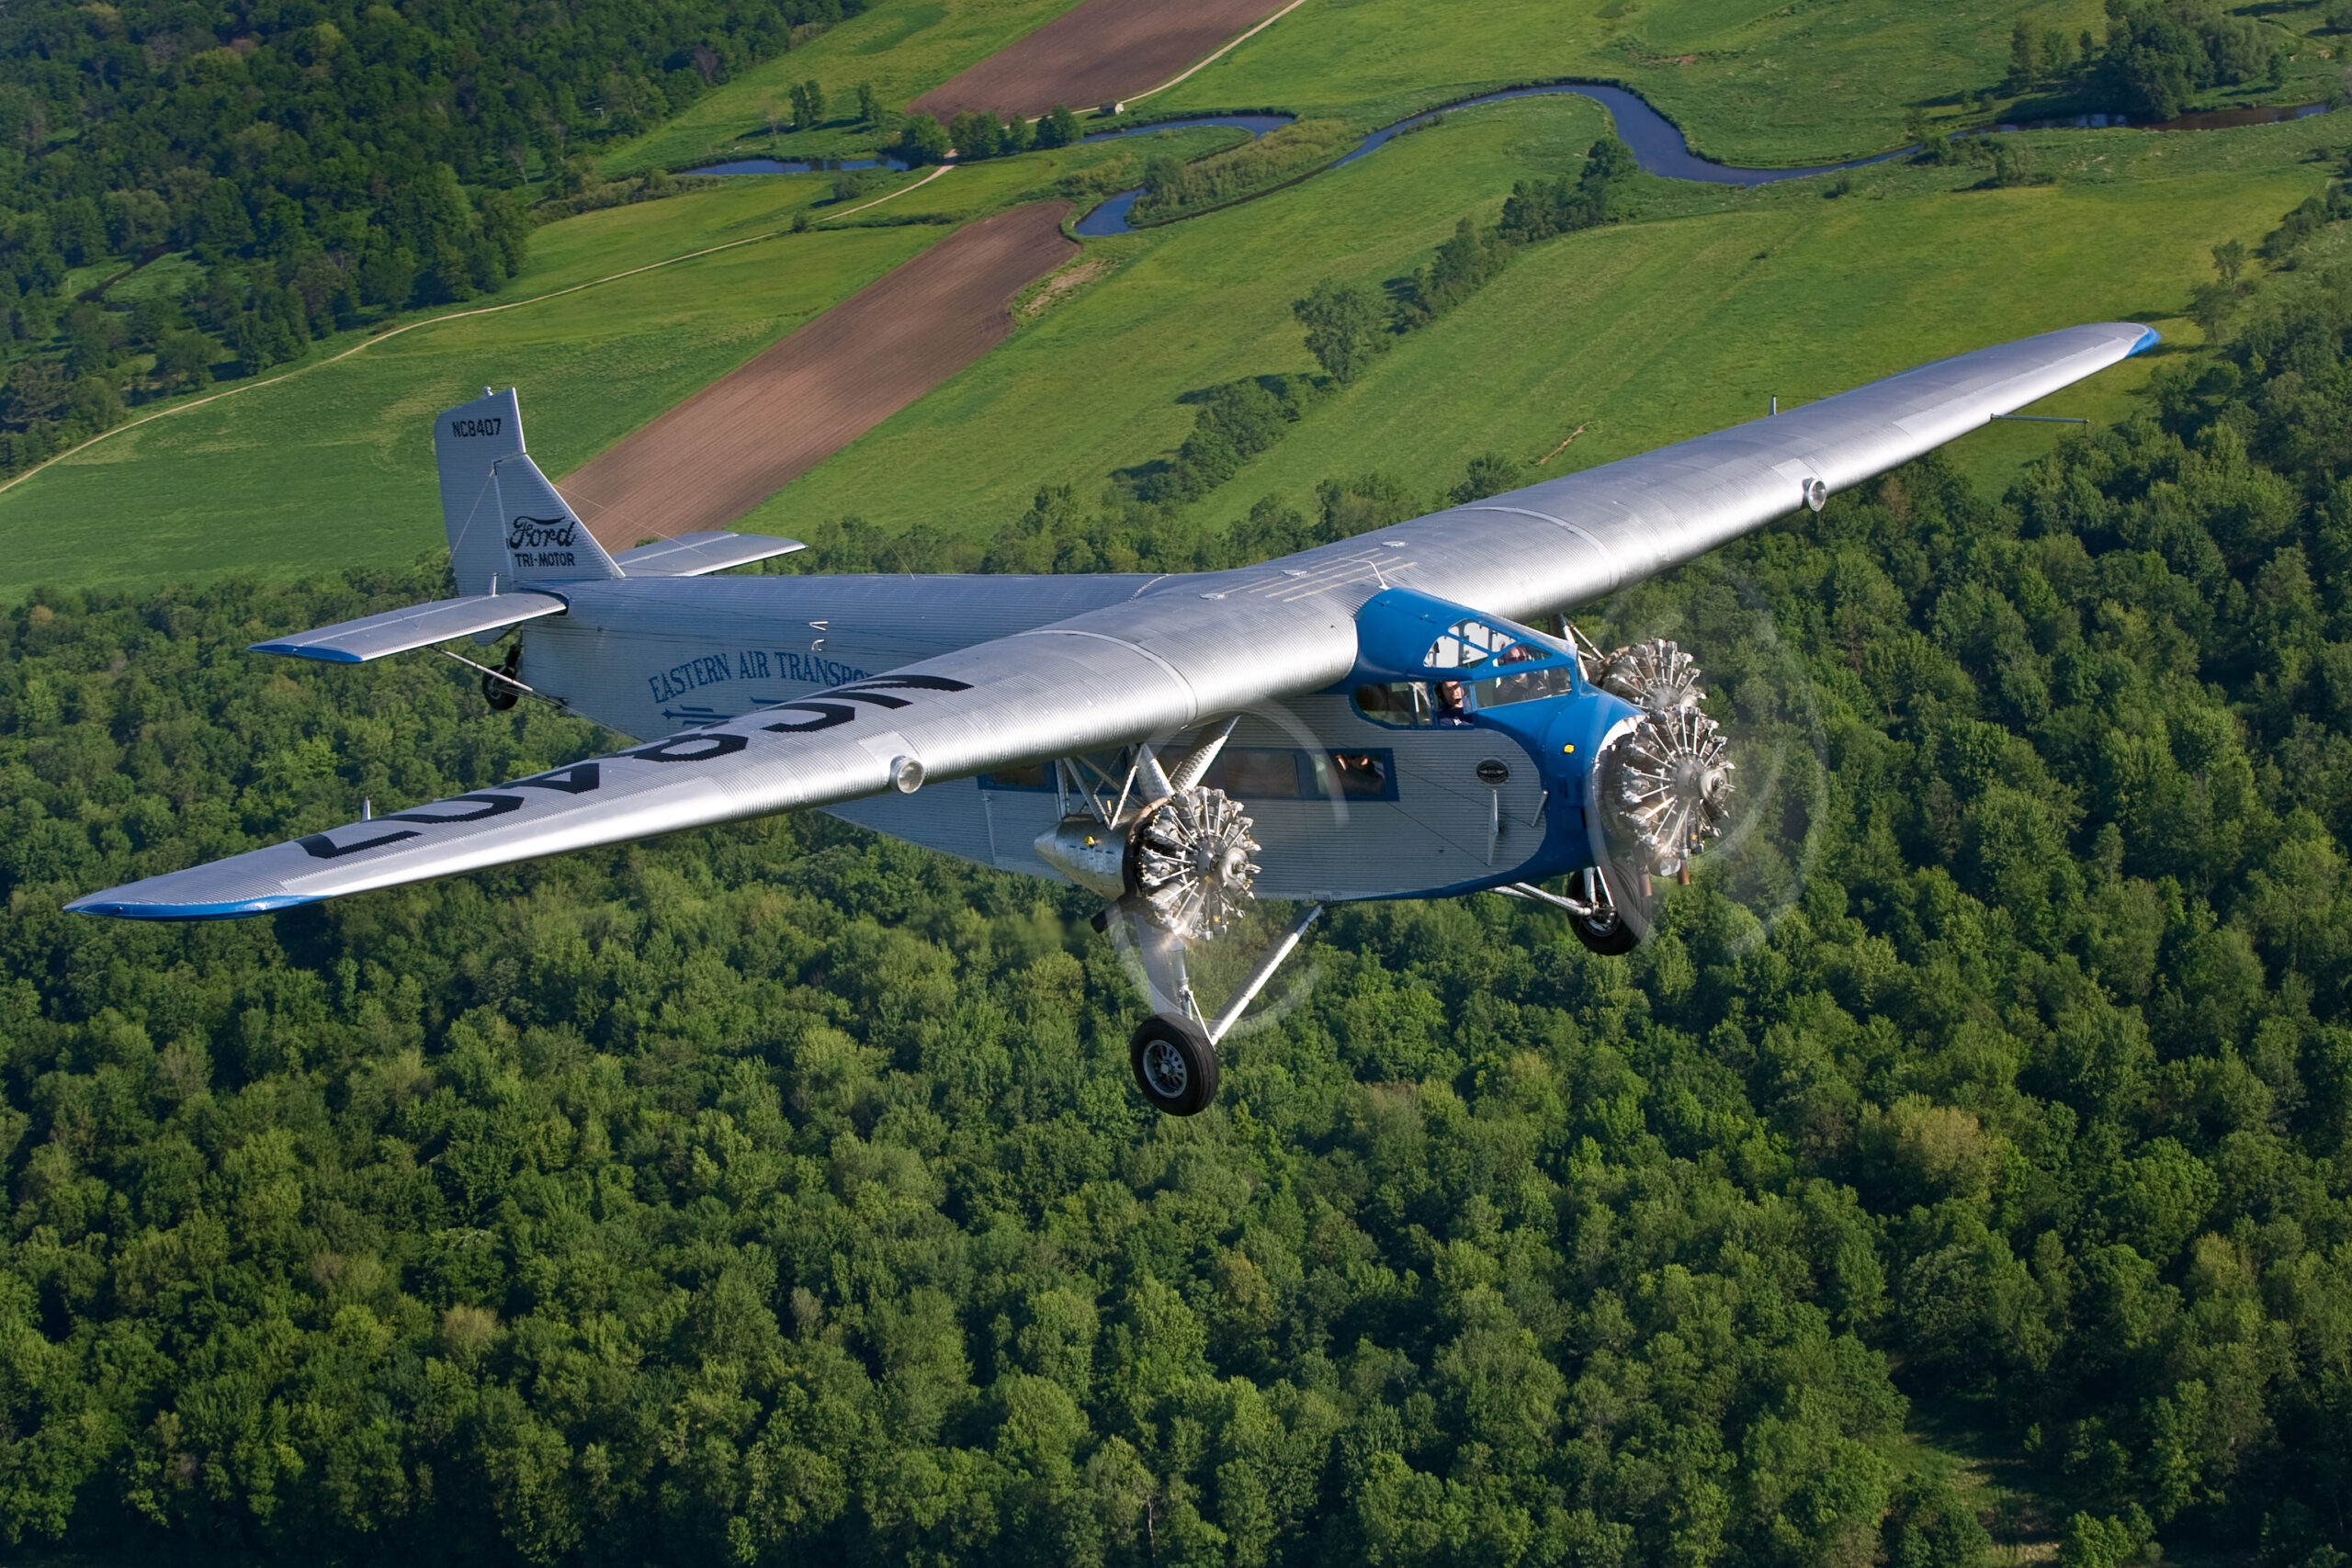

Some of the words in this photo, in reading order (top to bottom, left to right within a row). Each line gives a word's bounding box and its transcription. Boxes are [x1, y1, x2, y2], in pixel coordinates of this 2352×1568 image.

[452, 418, 502, 437] NC8407
[508, 516, 576, 549] Ford
[514, 553, 575, 568] TRI-MOTOR
[649, 653, 732, 704] EASTERN
[739, 650, 770, 680] AIR
[775, 651, 875, 687] TRANSPO
